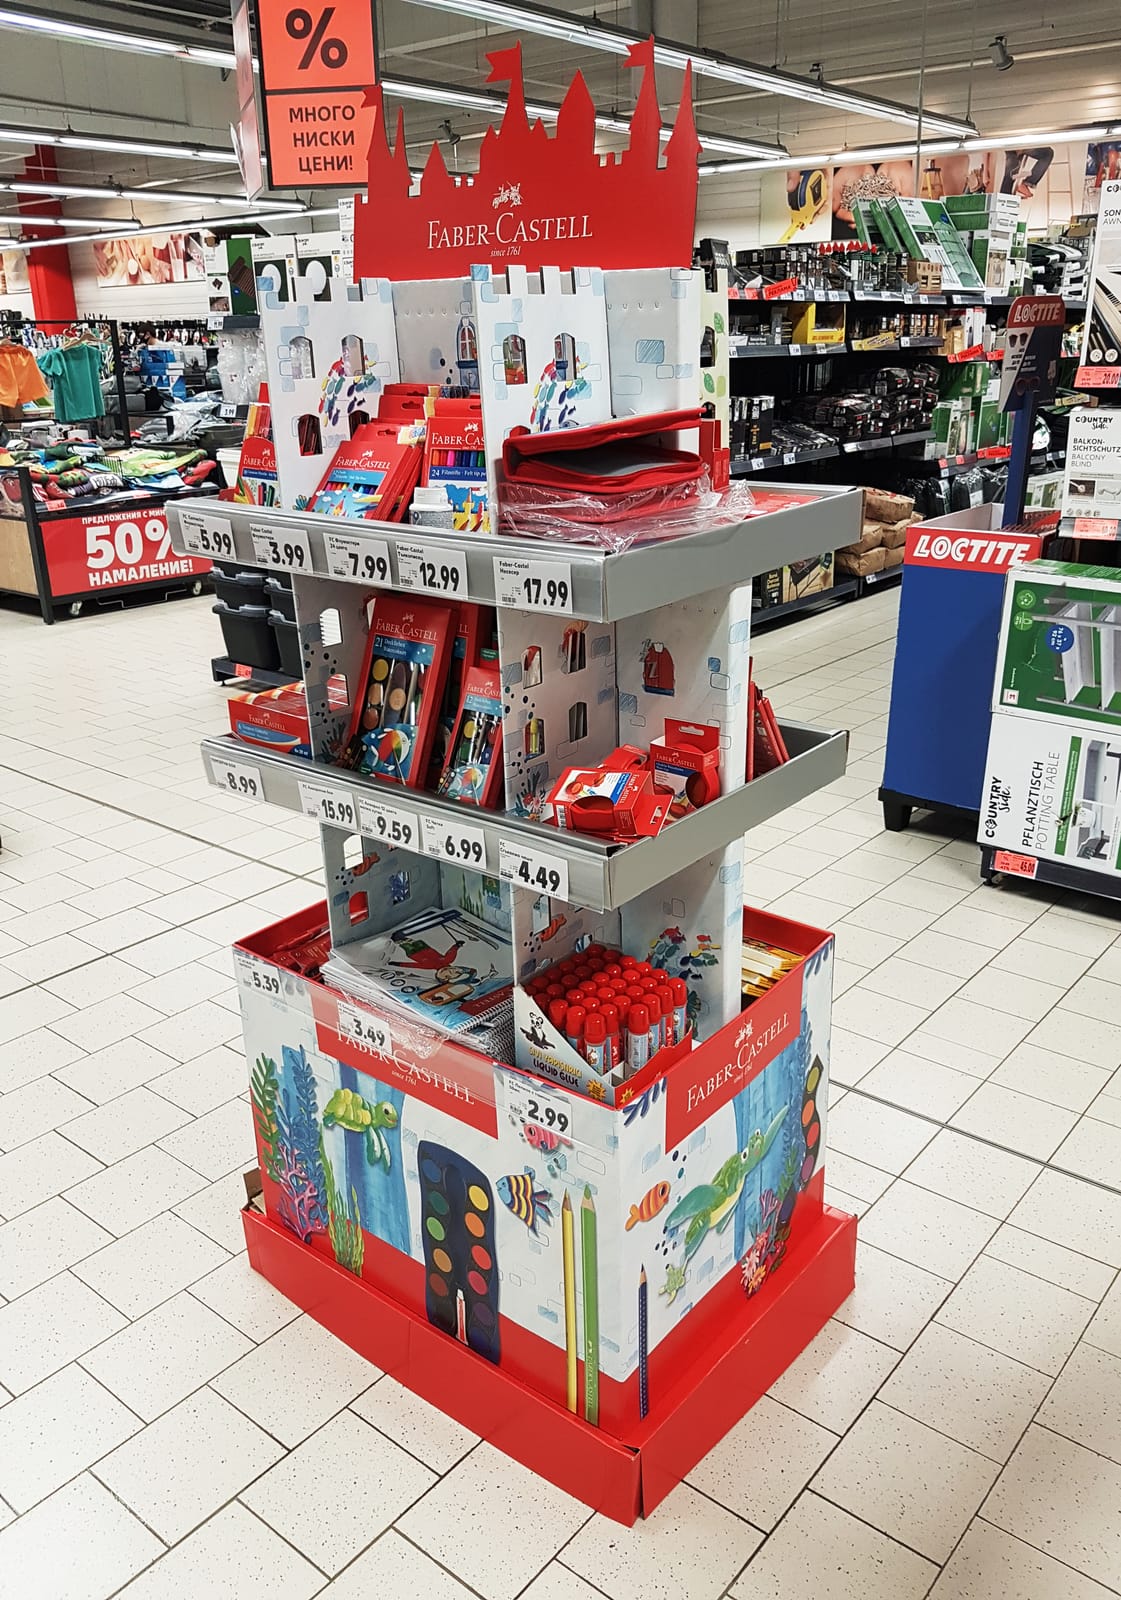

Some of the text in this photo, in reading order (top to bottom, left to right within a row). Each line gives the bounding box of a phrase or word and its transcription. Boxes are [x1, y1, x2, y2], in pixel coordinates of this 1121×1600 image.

[286, 7, 348, 70] %
[289, 105, 356, 123] МНОГО
[293, 130, 355, 148] НИСКИ
[298, 155, 353, 175] ЦЕНИ!
[1106, 184, 1121, 193] CO
[426, 212, 593, 250] FABER-CASTELL
[490, 246, 522, 257] since 1761
[1013, 302, 1062, 323] LOCTITE
[1075, 416, 1114, 424] COUNTRY
[1072, 445, 1121, 453] SICHTSCHUTZ
[1073, 437, 1105, 445] BALKON-
[336, 456, 391, 469] FABER-CASTELL
[431, 469, 440, 477] 24
[81, 511, 141, 525] ПРЕДЛОЖЕНИЯ
[86, 519, 187, 569] 50%
[200, 528, 232, 555] 5.99
[269, 541, 305, 567] 3.99
[913, 534, 1031, 566] LOCTITE
[88, 559, 194, 587] НАМАЛЕНИЕ!
[348, 552, 387, 580] 7.99
[419, 562, 460, 591] 12.99
[523, 577, 569, 607] 17.99
[375, 619, 438, 640] FABER-CASTELL
[227, 772, 257, 796] 8.99
[321, 798, 353, 824] 15.99
[984, 776, 1003, 838] COUNTRY
[1022, 761, 1044, 847] PFLANZTISCH
[1035, 751, 1061, 851] POTTING TABLE
[377, 815, 412, 844] 9.59
[445, 835, 483, 863] 6.99
[518, 860, 561, 892] 4.49
[252, 971, 280, 994] 5.39
[353, 1018, 386, 1046] 3.49
[532, 1058, 580, 1088] LIQUID GLUE
[687, 1012, 790, 1113] FABER-CASTELL
[391, 1070, 417, 1086] since 1761
[527, 1099, 569, 1132] 2.99
